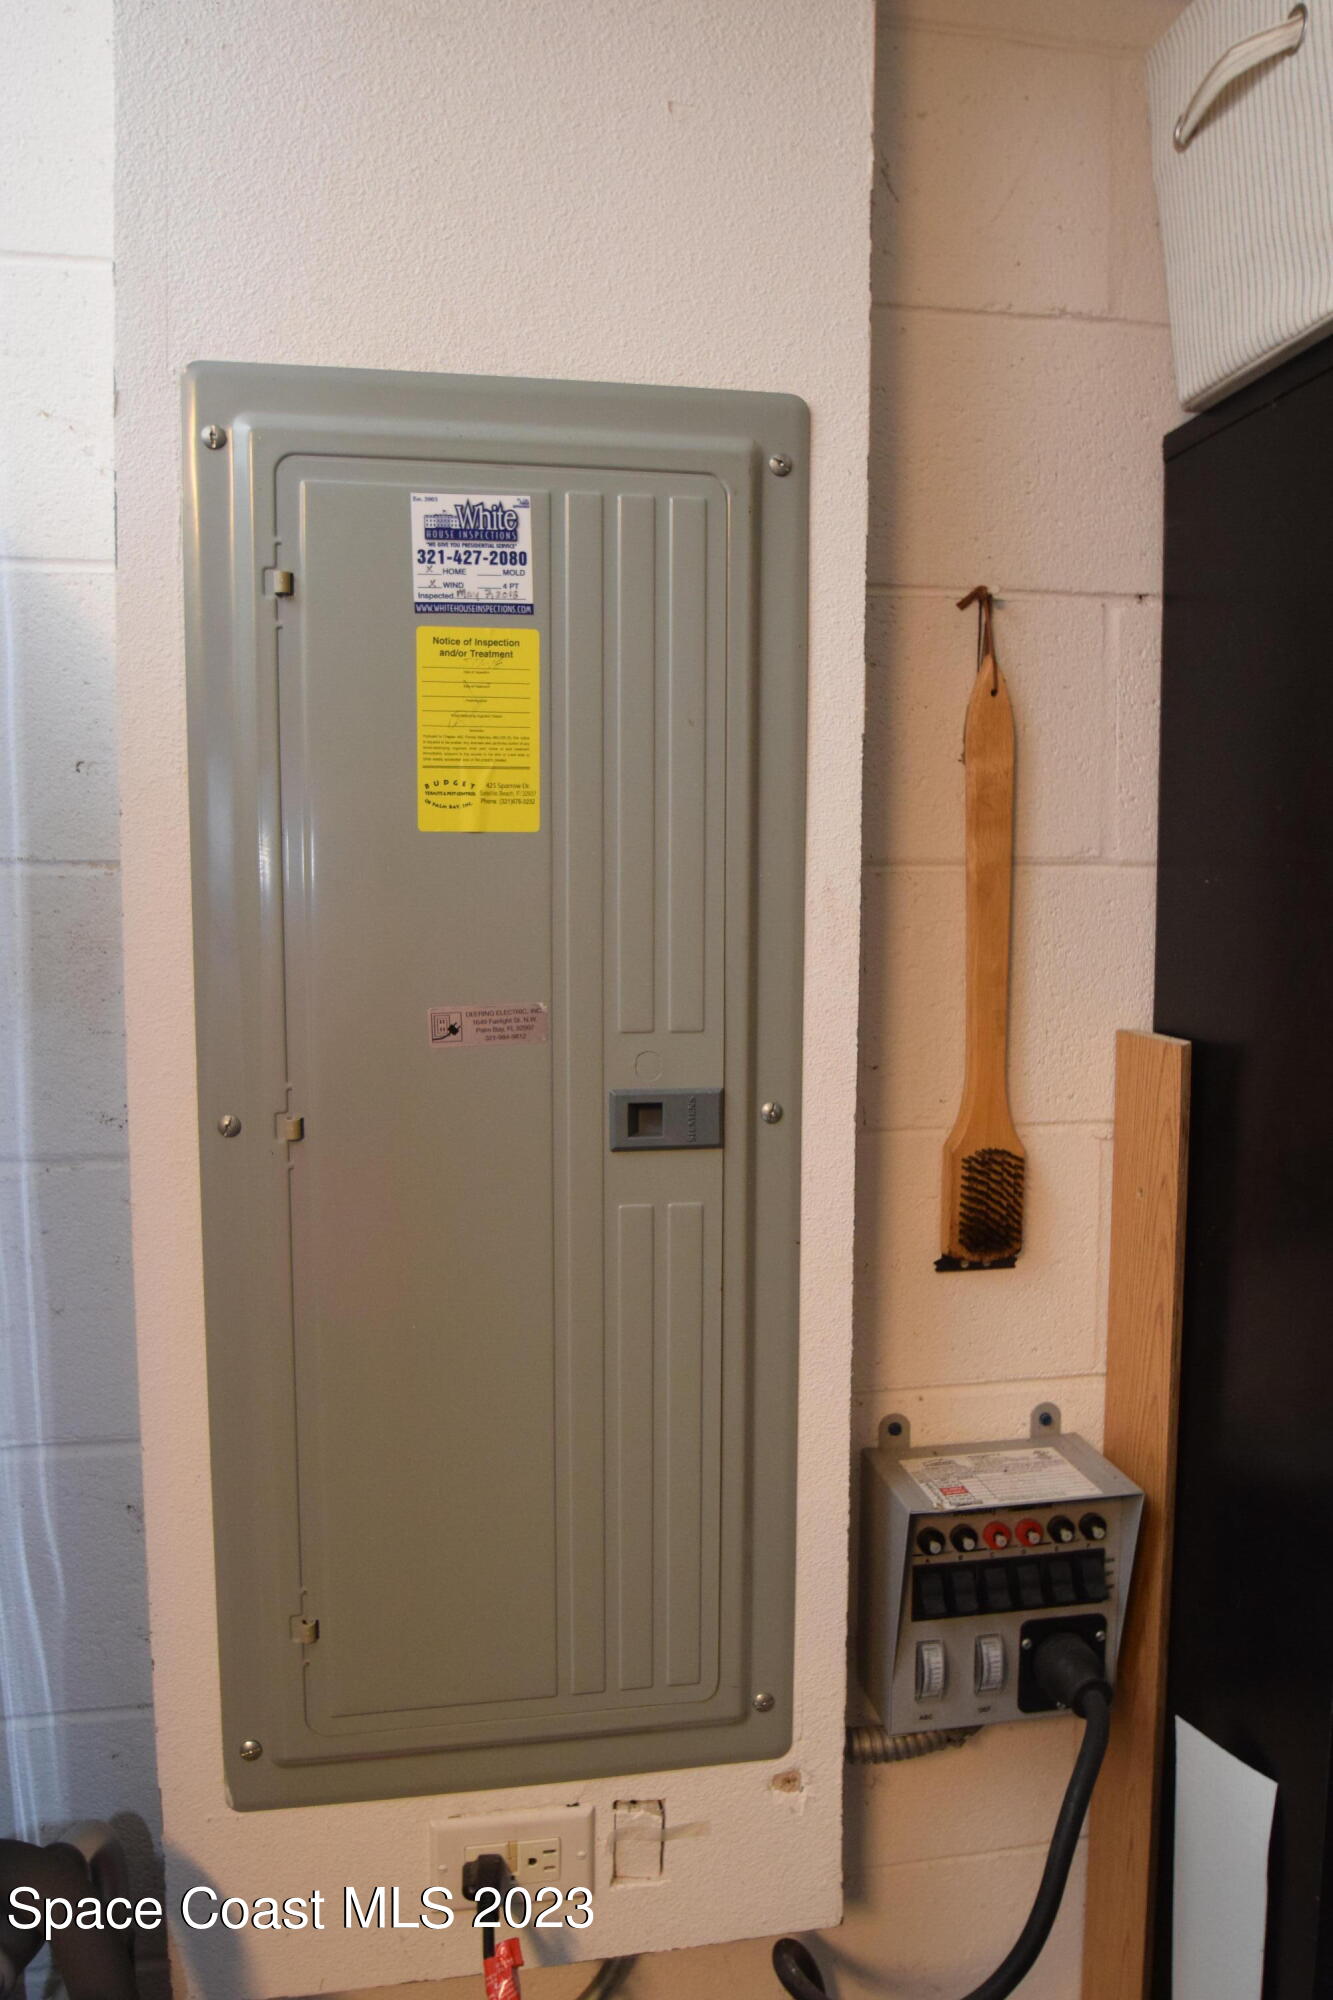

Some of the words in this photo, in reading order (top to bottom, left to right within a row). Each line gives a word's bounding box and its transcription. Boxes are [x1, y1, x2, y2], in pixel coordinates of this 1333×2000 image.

[455, 499, 518, 531] White
[426, 530, 454, 539] HOUSE
[459, 530, 517, 541] INSPECTIONS
[417, 549, 527, 566] 321-427-2080
[416, 604, 532, 613] WWW.WHITEHOUSEINSPECTIONS.COM
[433, 636, 460, 645] Notice
[464, 637, 472, 646] of
[475, 638, 520, 648] Inspection
[440, 649, 467, 658] and/or
[470, 650, 513, 658] Treatment
[424, 780, 475, 789] BUDGET
